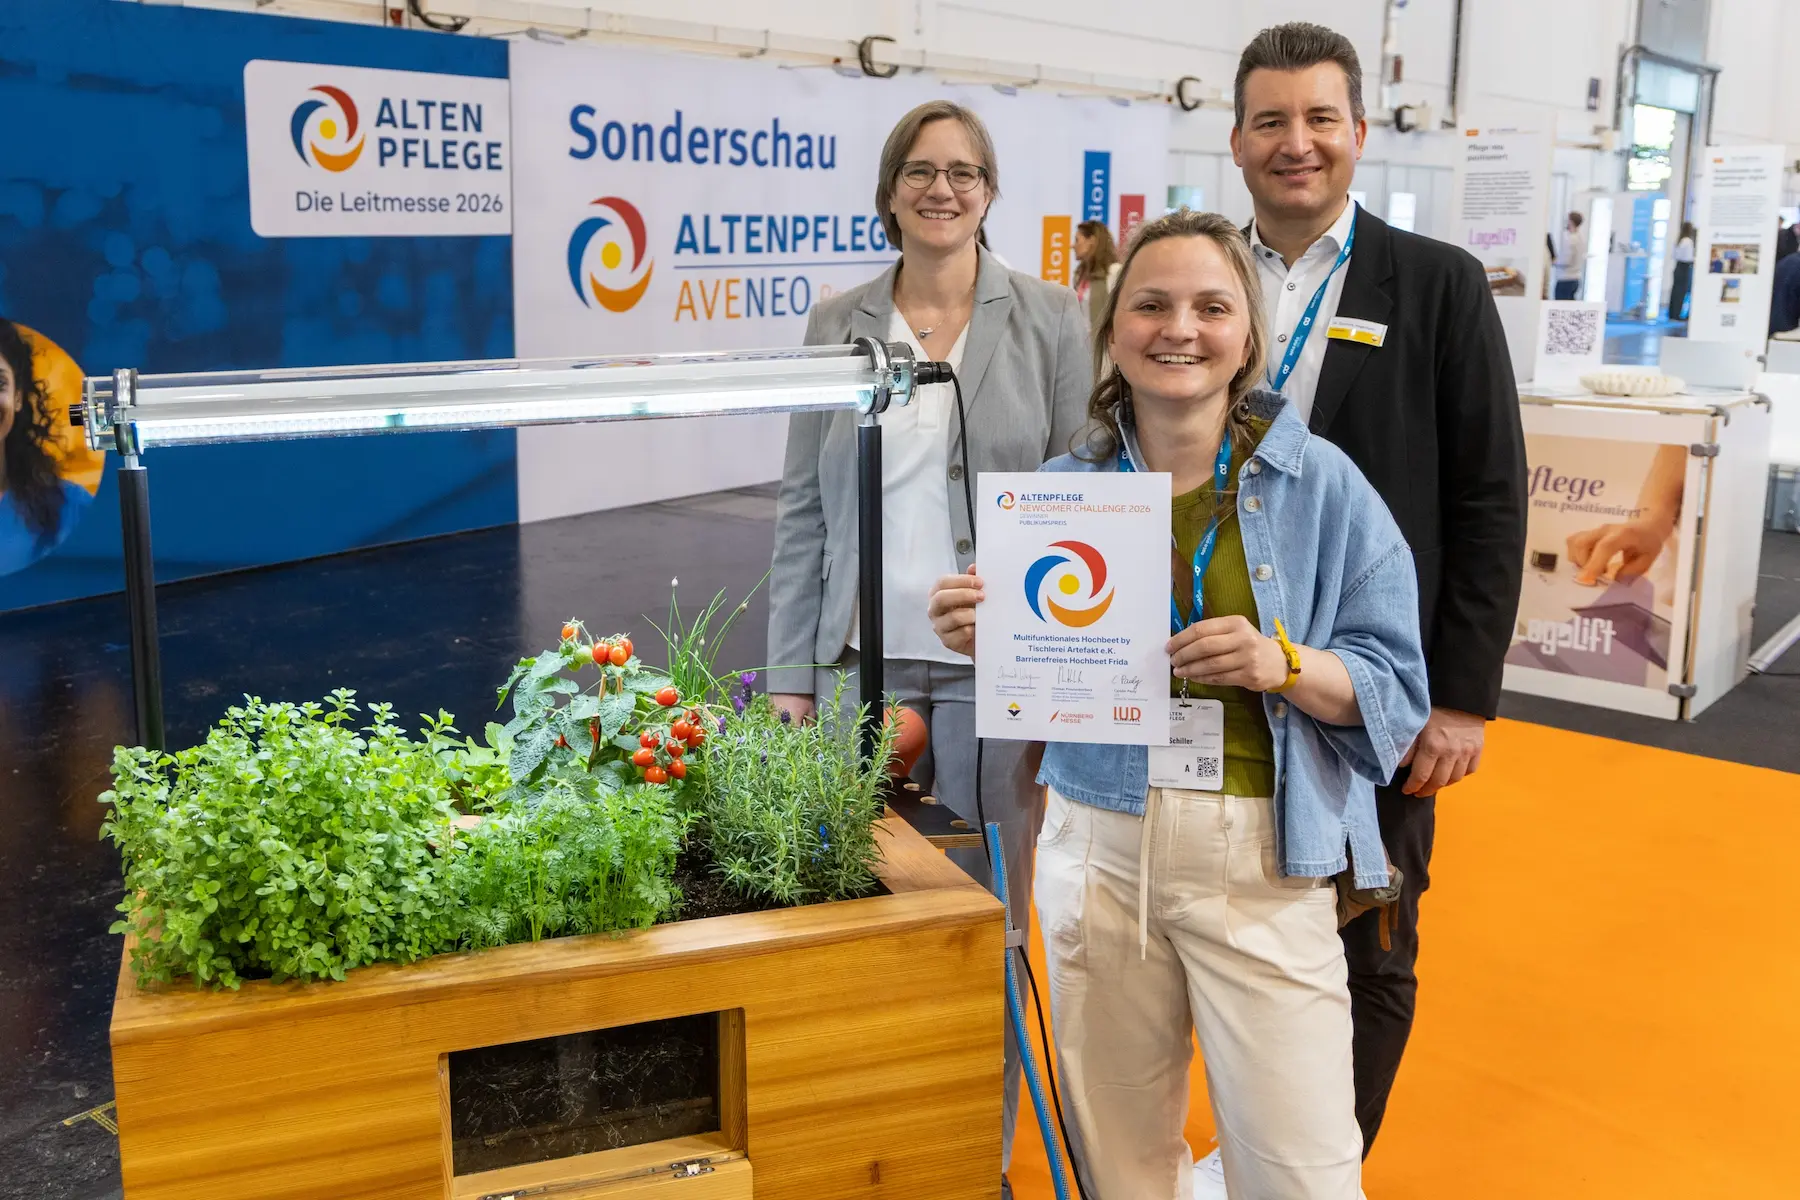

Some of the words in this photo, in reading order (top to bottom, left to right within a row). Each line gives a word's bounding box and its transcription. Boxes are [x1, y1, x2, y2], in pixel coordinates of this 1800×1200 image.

[375, 97, 483, 133] ALTEN
[568, 103, 836, 170] Sonderschau
[378, 137, 503, 170] PFLEGE
[295, 190, 334, 212] Die
[340, 191, 450, 213] Leitmesse
[455, 193, 504, 213] 2026
[674, 213, 897, 255] ALTENPFLEG
[674, 276, 811, 322] AVENEO
[1528, 465, 1605, 501] flege
[1020, 493, 1084, 502] ALTENPFLEGE
[1019, 504, 1072, 513] NEWCOMER
[1073, 504, 1127, 514] CHALLENGE
[1128, 505, 1151, 513] 2026
[1013, 634, 1080, 643] Multifunktionales
[1081, 636, 1119, 644] Hochbeet
[1120, 636, 1131, 645] by
[1028, 645, 1066, 653] Tischlerei
[1067, 646, 1099, 655] Artefakt
[1100, 647, 1116, 655] e.K.
[1015, 656, 1068, 664] Barrierefreies
[1069, 657, 1107, 665] Hochbeet
[1108, 658, 1129, 666] Frida
[1113, 706, 1141, 720] IUD
[1184, 764, 1191, 773] A
